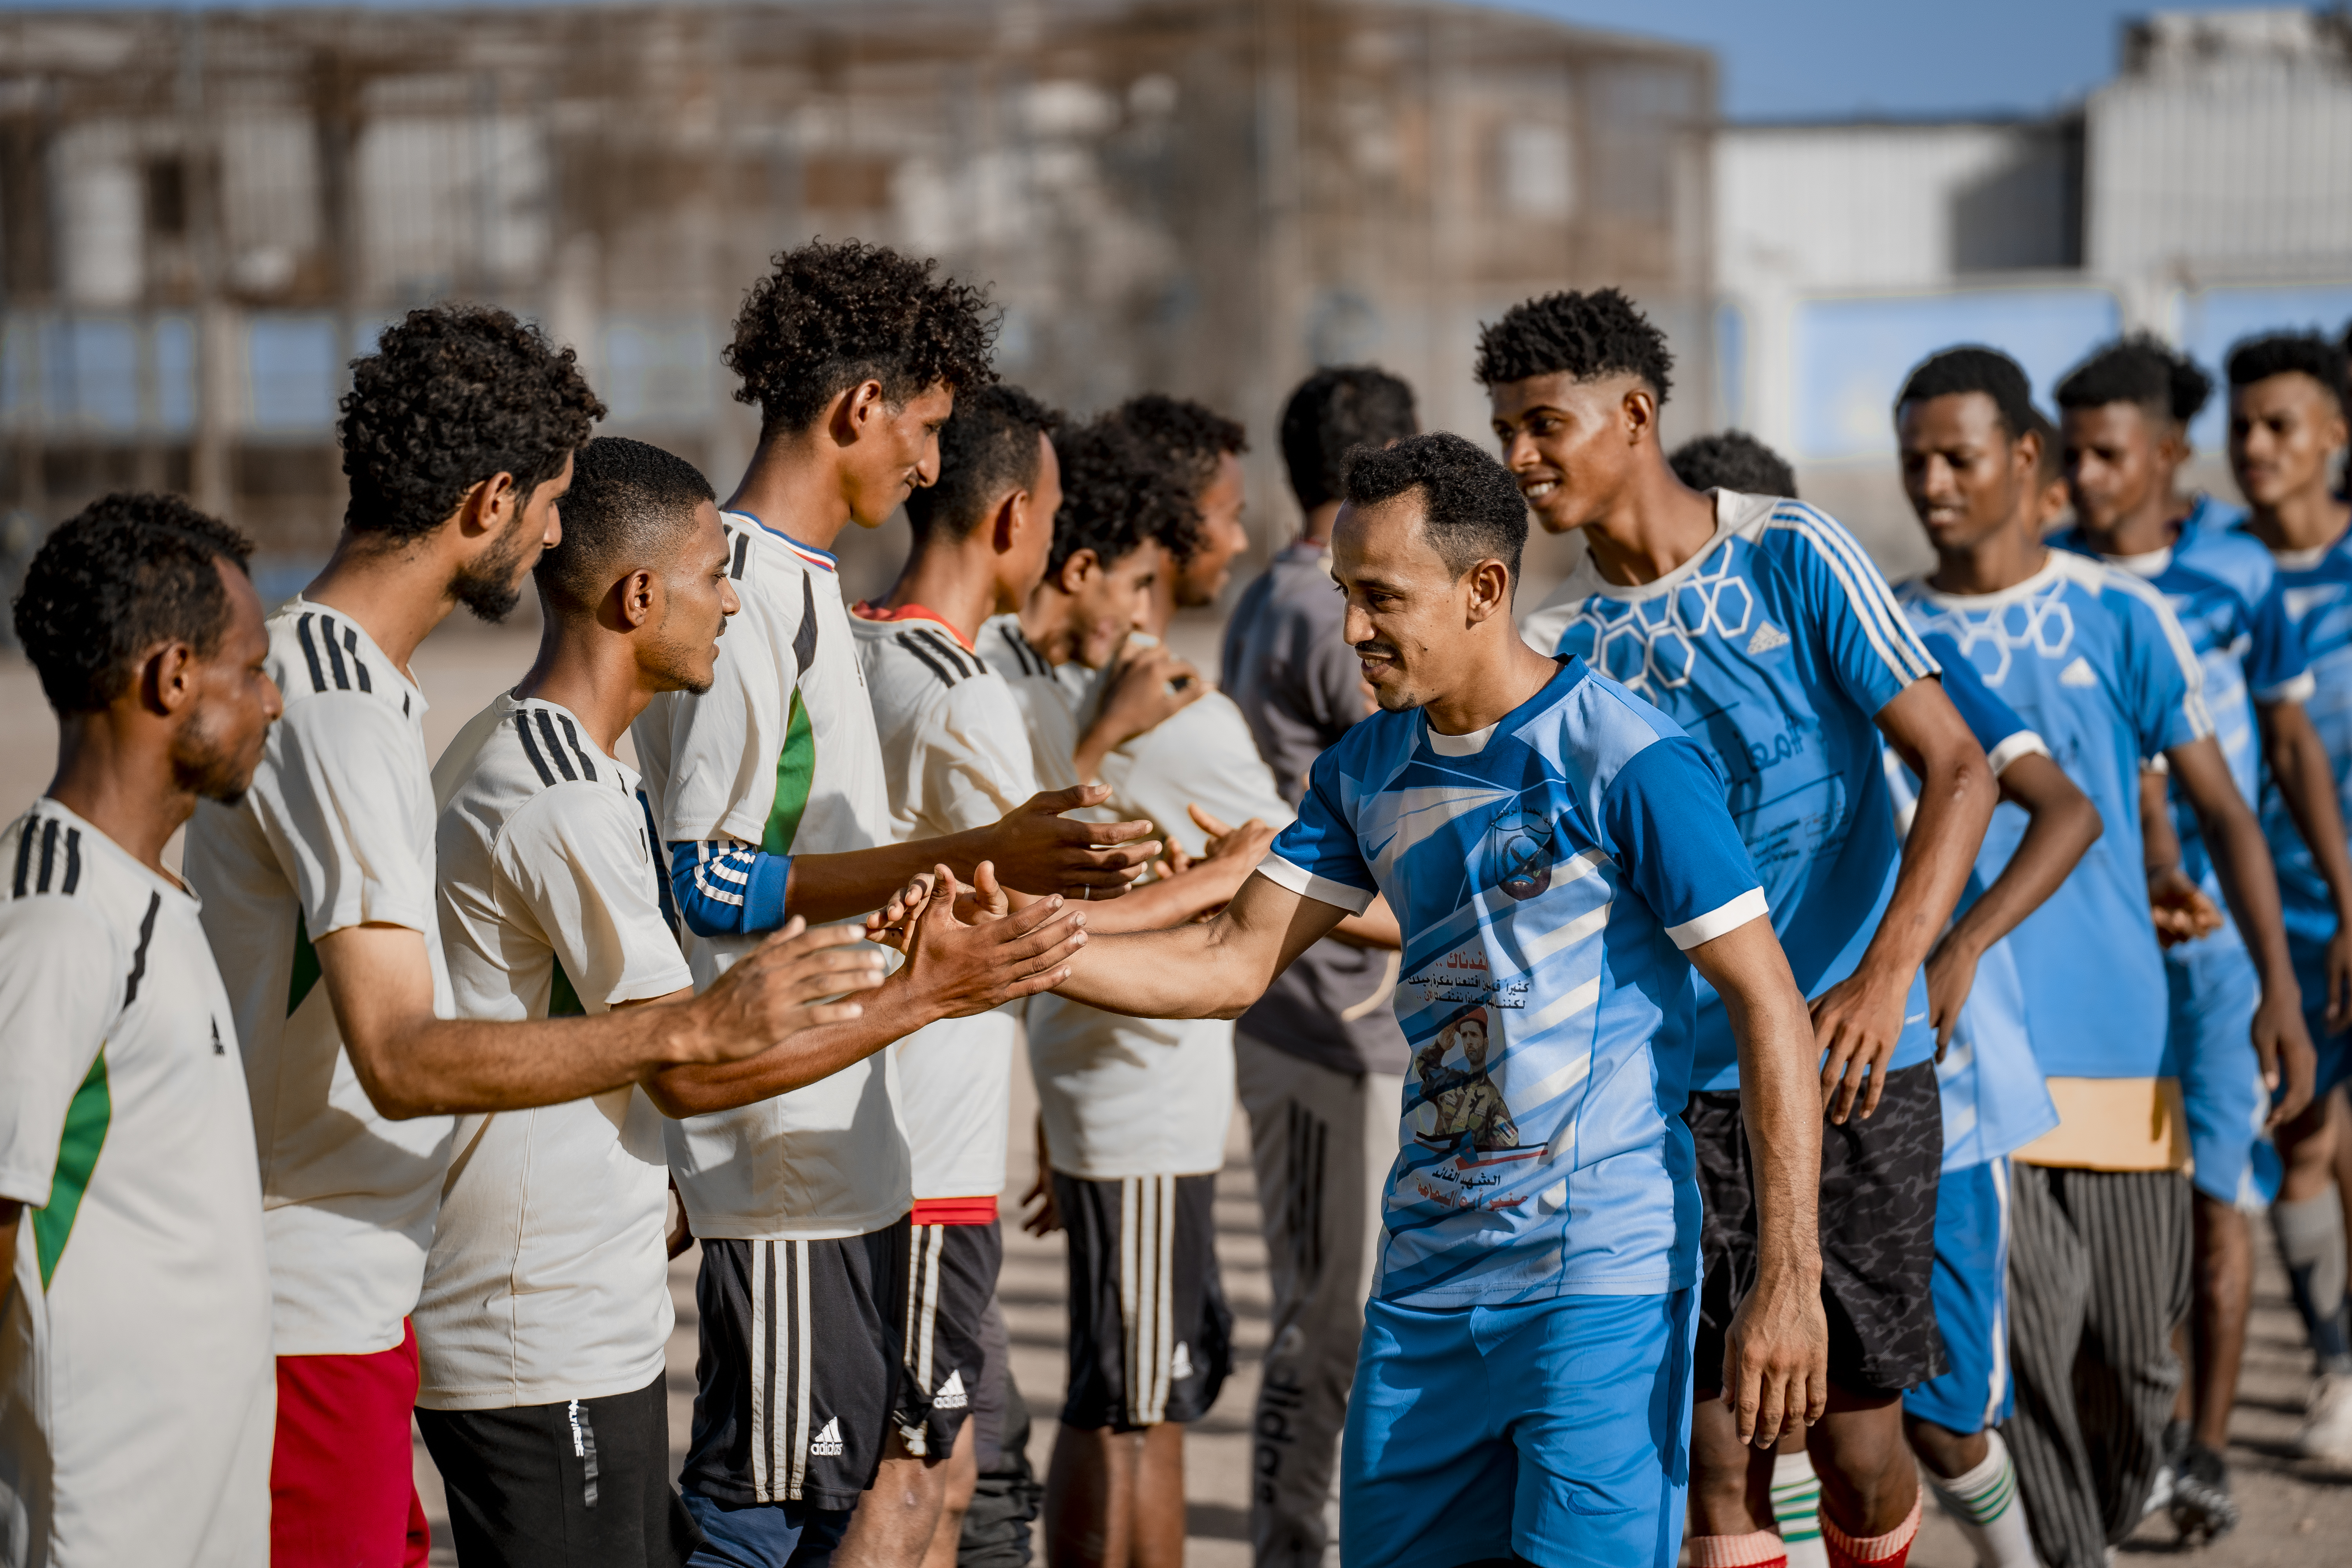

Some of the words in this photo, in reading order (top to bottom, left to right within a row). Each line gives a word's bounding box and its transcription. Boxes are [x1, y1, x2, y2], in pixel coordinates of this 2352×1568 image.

[1460, 1172, 1501, 1190] الشهيد
[1486, 1192, 1528, 1212] منير
[933, 1394, 968, 1409] adidas
[810, 1441, 843, 1456] adidas
